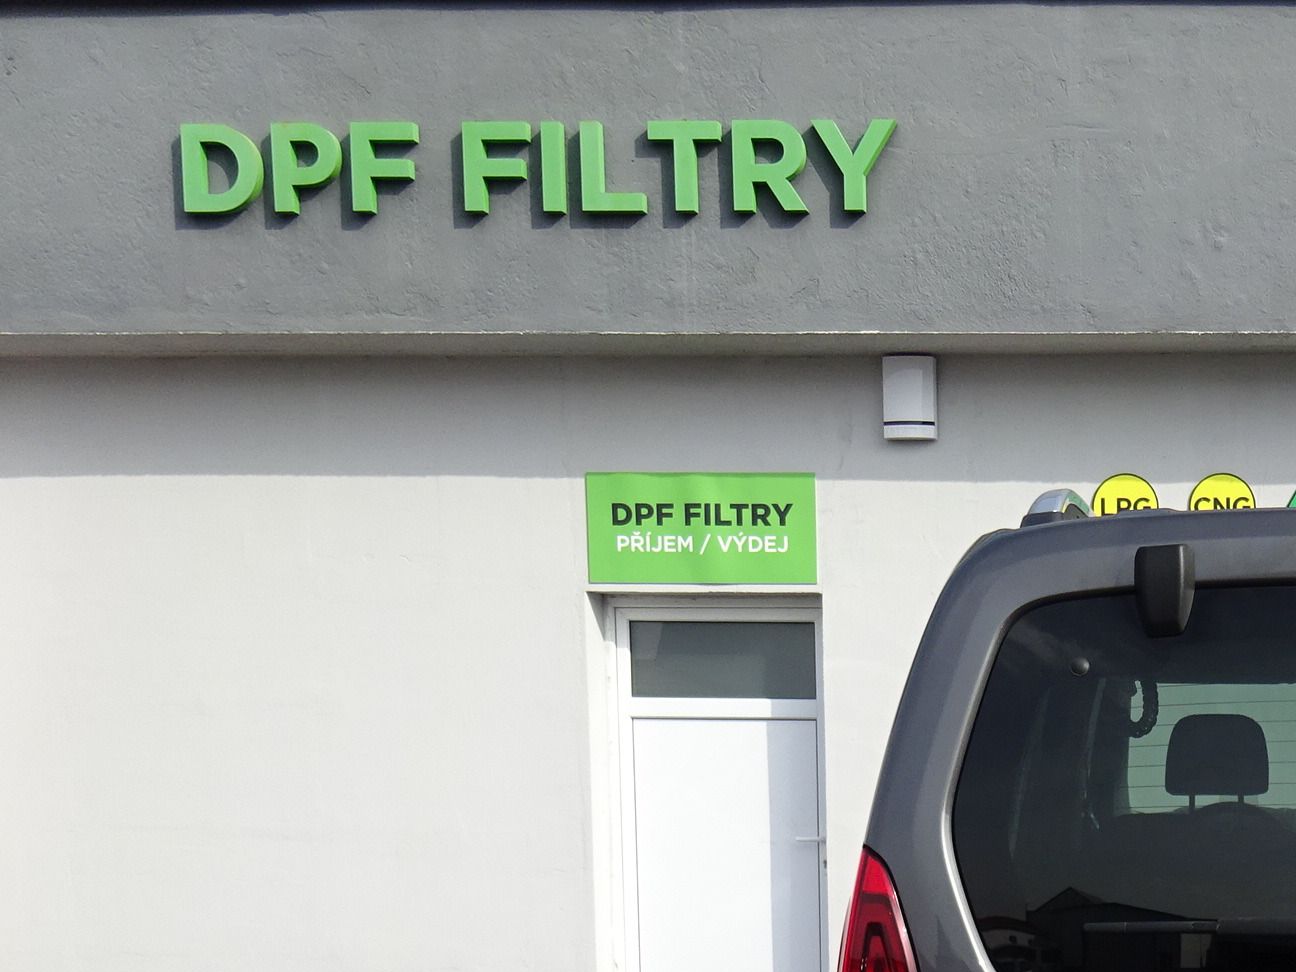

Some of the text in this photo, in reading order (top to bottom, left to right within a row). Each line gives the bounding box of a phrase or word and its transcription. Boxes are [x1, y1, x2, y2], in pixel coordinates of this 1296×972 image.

[180, 118, 898, 216] DPF FILTRY
[610, 502, 794, 527] DPF FILTRY
[1194, 497, 1251, 511] CNG
[616, 531, 789, 555] PŘÍJEM / VÝDEJ
